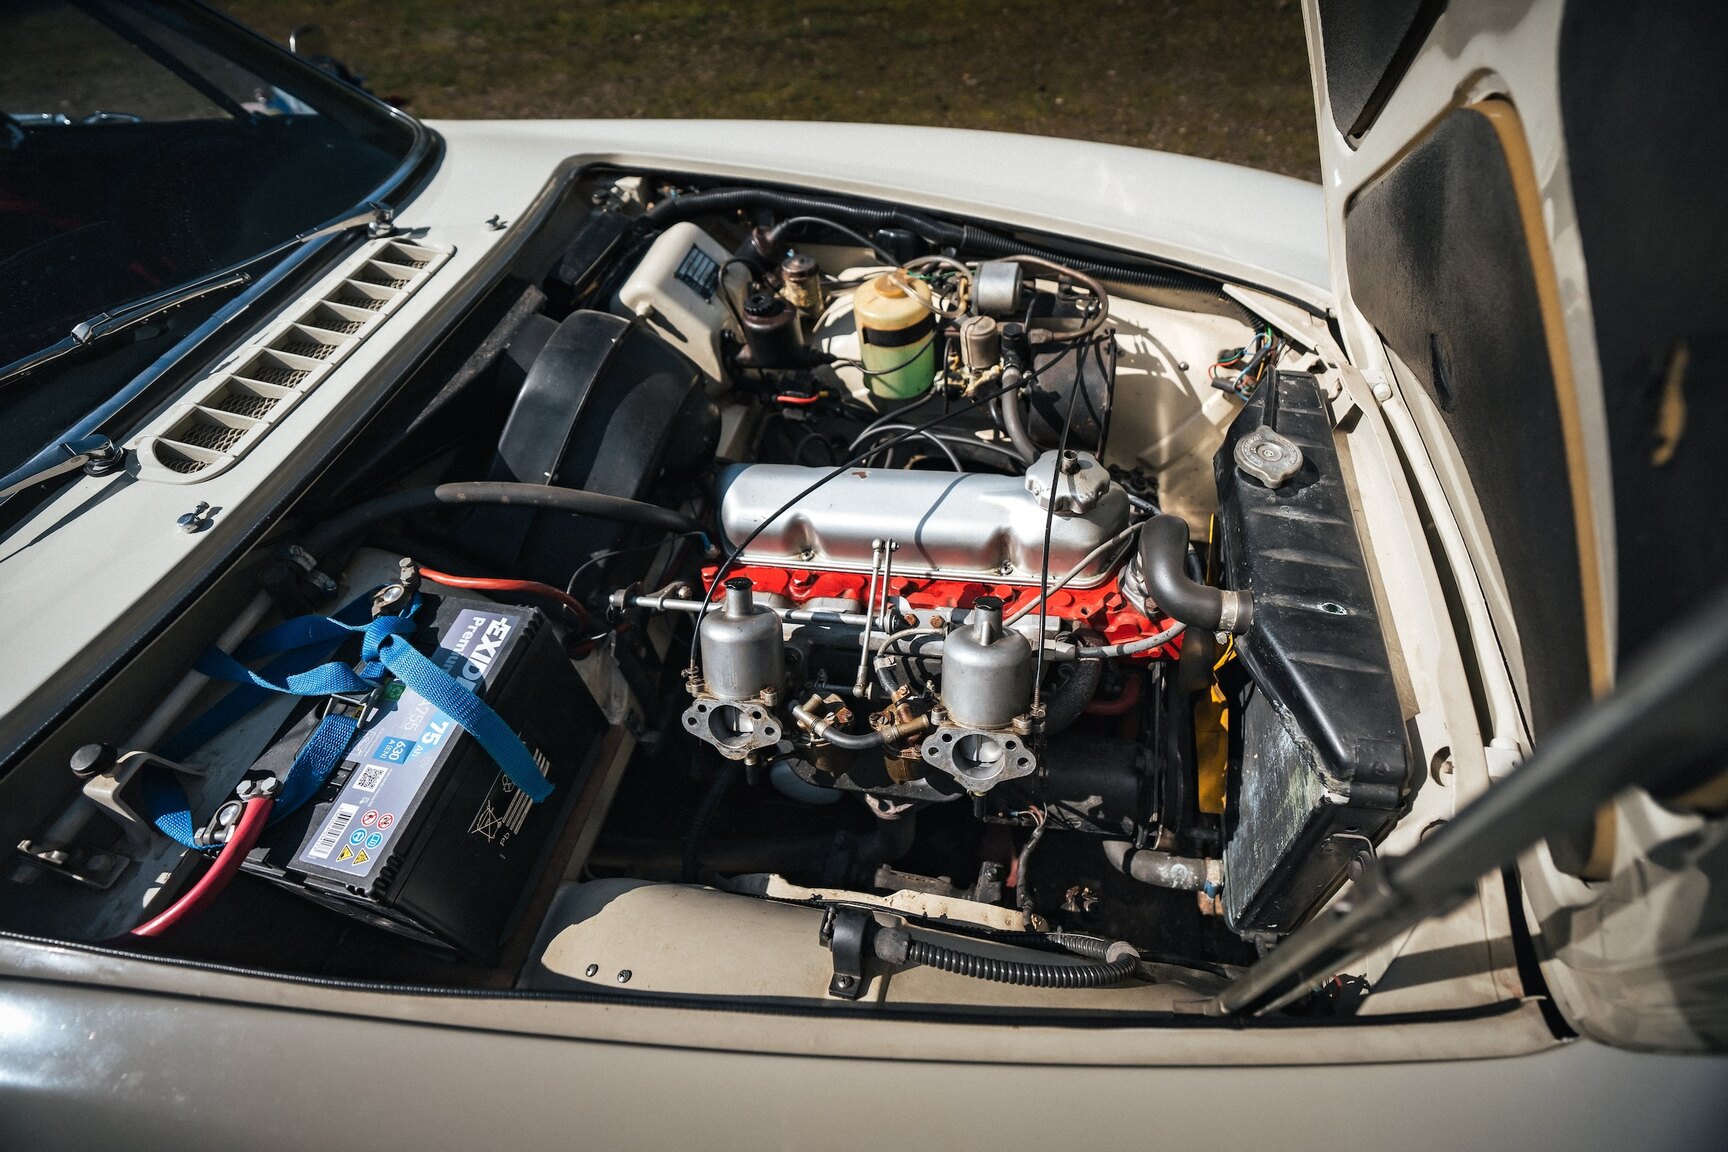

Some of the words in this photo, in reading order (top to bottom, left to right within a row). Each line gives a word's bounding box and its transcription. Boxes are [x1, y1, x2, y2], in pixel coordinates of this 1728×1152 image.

[421, 721, 450, 745] 75
[388, 741, 406, 761] 630
[411, 744, 424, 757] Ah
